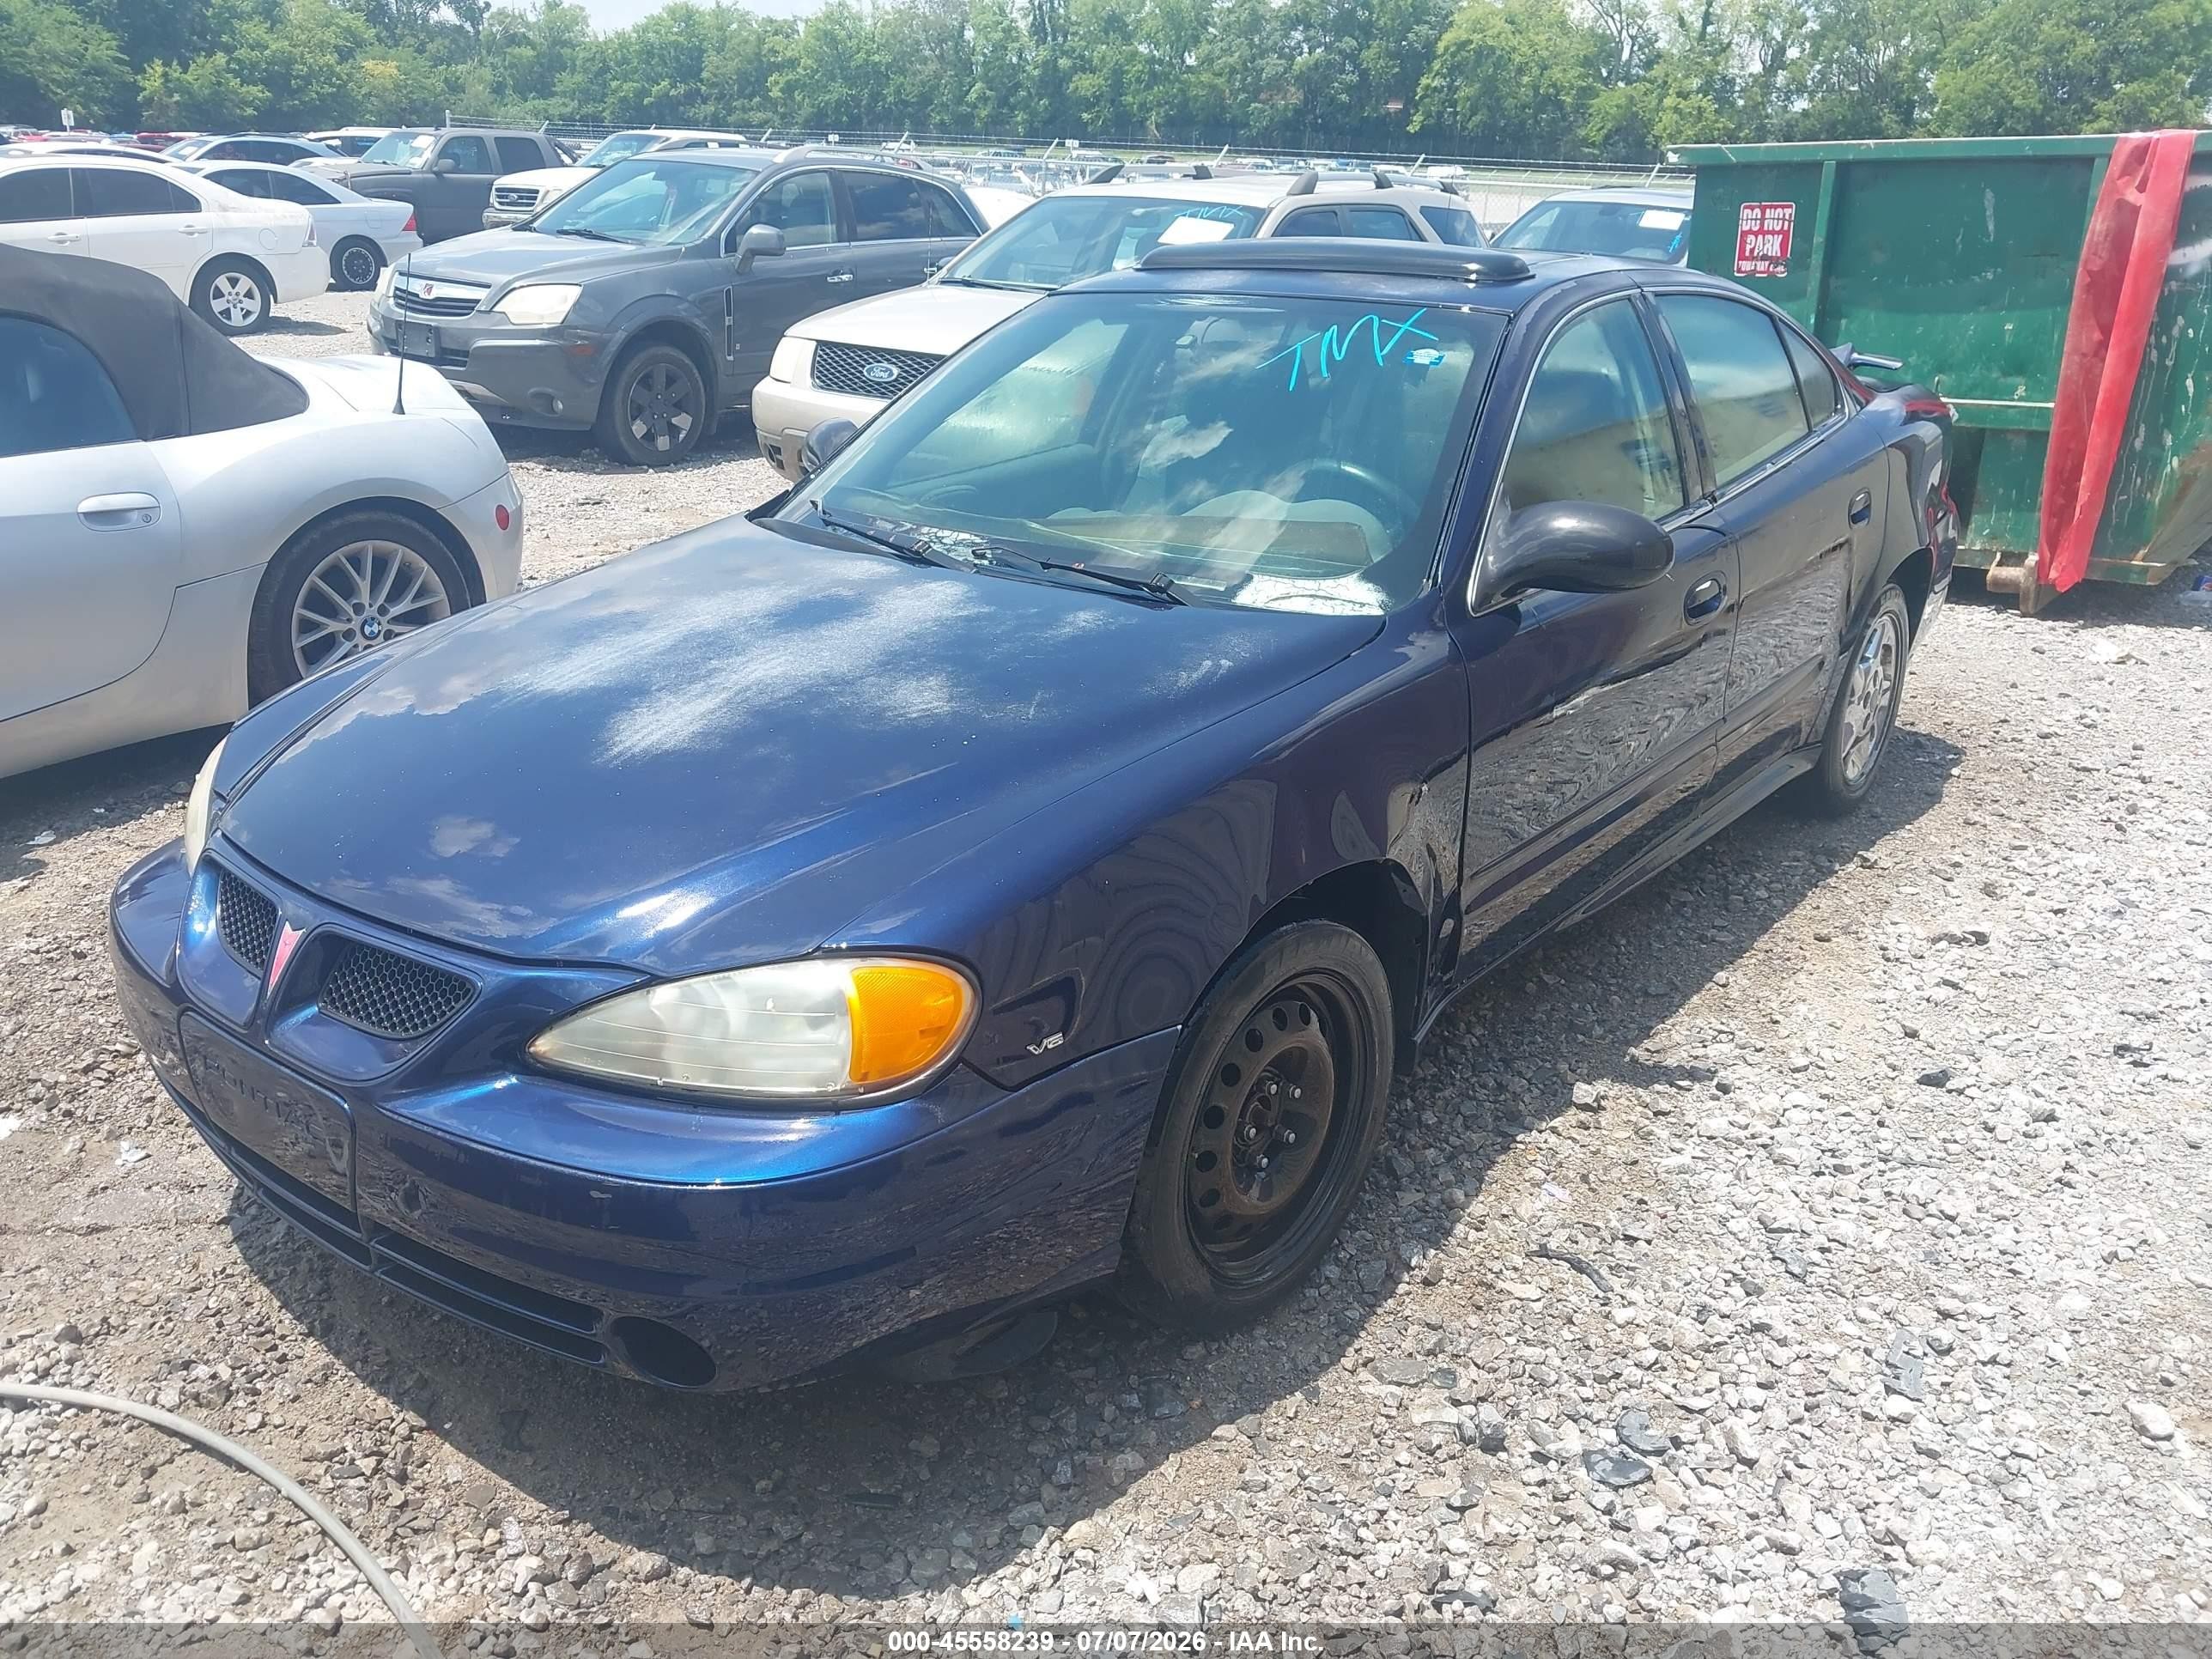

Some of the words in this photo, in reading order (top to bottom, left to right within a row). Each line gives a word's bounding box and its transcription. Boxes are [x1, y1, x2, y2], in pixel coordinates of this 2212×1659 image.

[1742, 208, 1761, 231] DO
[1763, 208, 1792, 231] NOT
[1745, 234, 1783, 257] PARK
[1255, 307, 1439, 392] TMX
[871, 366, 890, 379] Ford
[1026, 1031, 1064, 1055] V6
